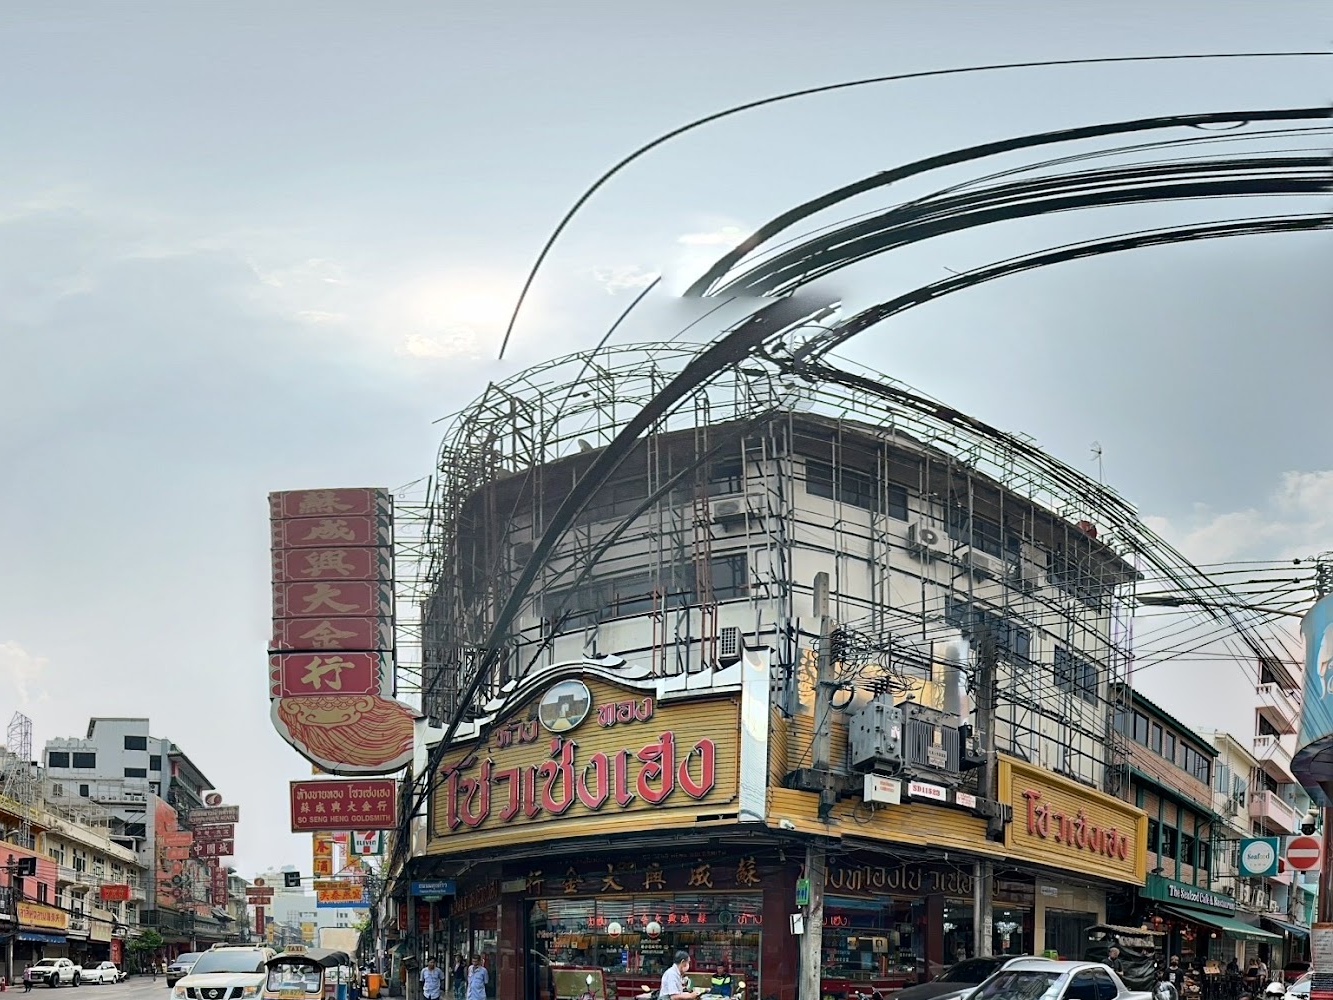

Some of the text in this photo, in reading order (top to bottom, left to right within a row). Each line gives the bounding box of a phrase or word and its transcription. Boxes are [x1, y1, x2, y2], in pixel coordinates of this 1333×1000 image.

[595, 697, 654, 728] ทอง
[912, 784, 941, 797] SD11523
[297, 814, 391, 824] SO SENG HENG GOLDSMITH
[1169, 885, 1181, 898] The
[1181, 888, 1200, 902] Seafood
